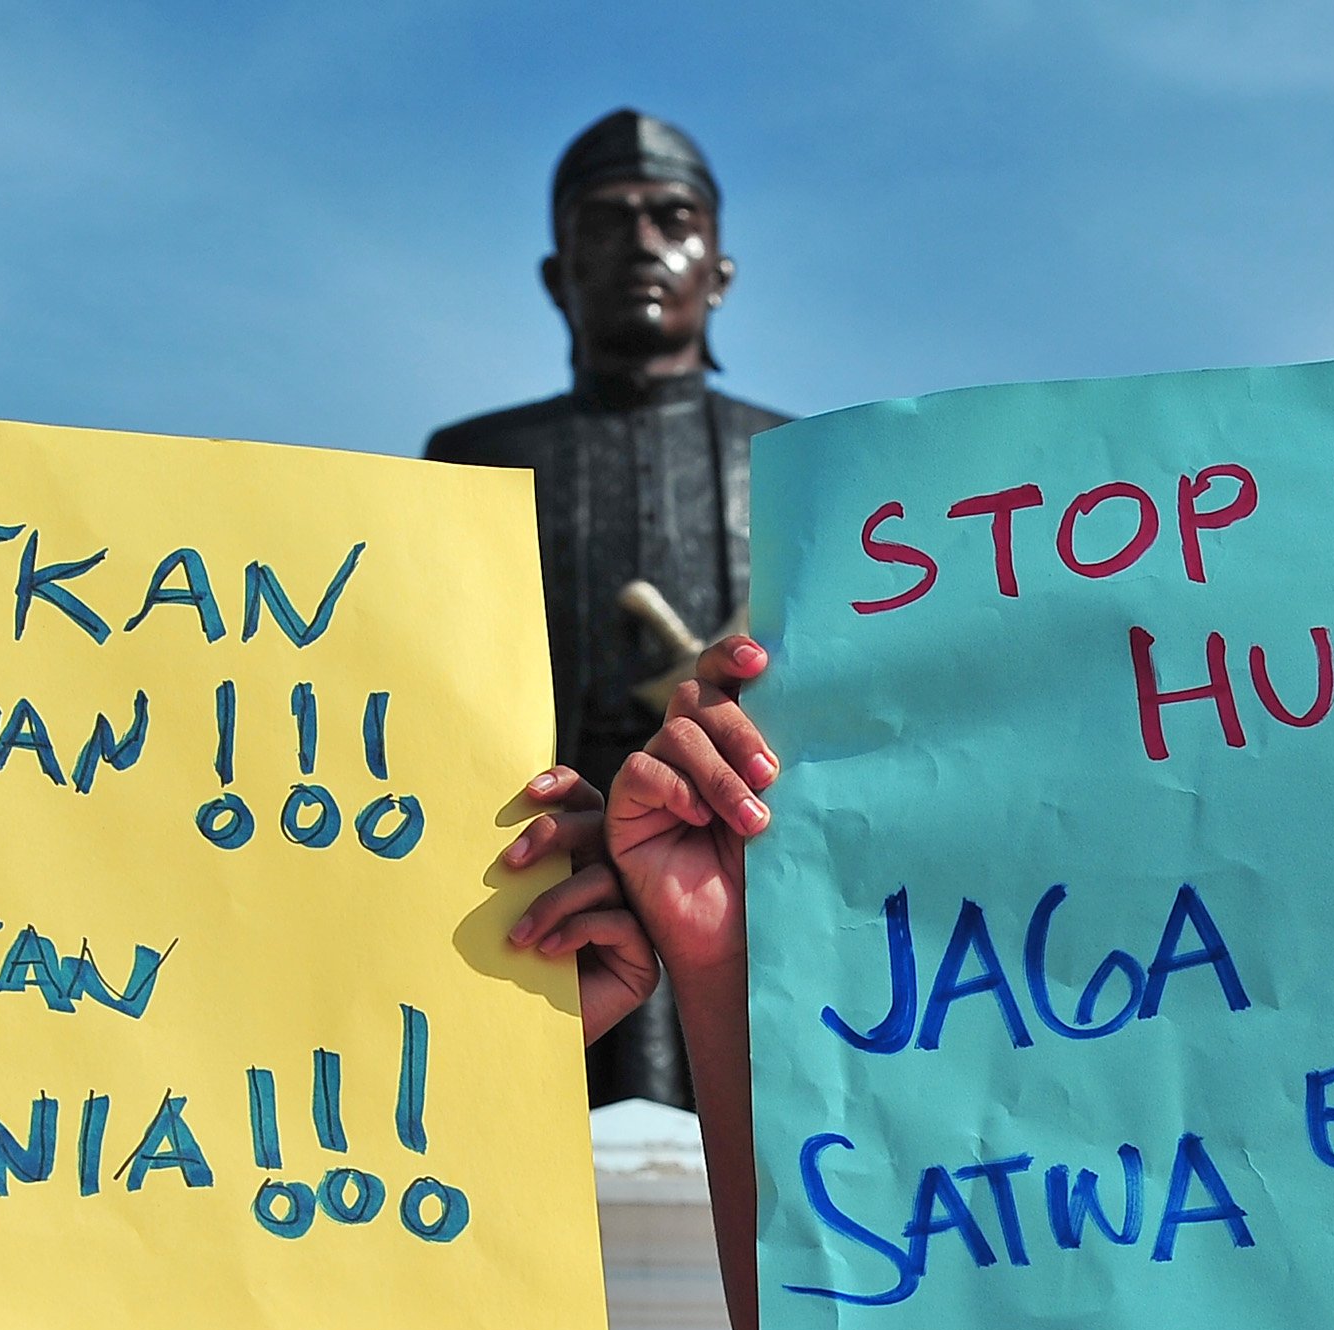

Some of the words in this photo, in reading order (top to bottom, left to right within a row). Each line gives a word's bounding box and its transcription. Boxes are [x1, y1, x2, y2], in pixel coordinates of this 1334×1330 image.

[849, 462, 1258, 615] STOP
[819, 881, 1252, 1056] JAGA
[783, 1131, 1255, 1308] SATWA
